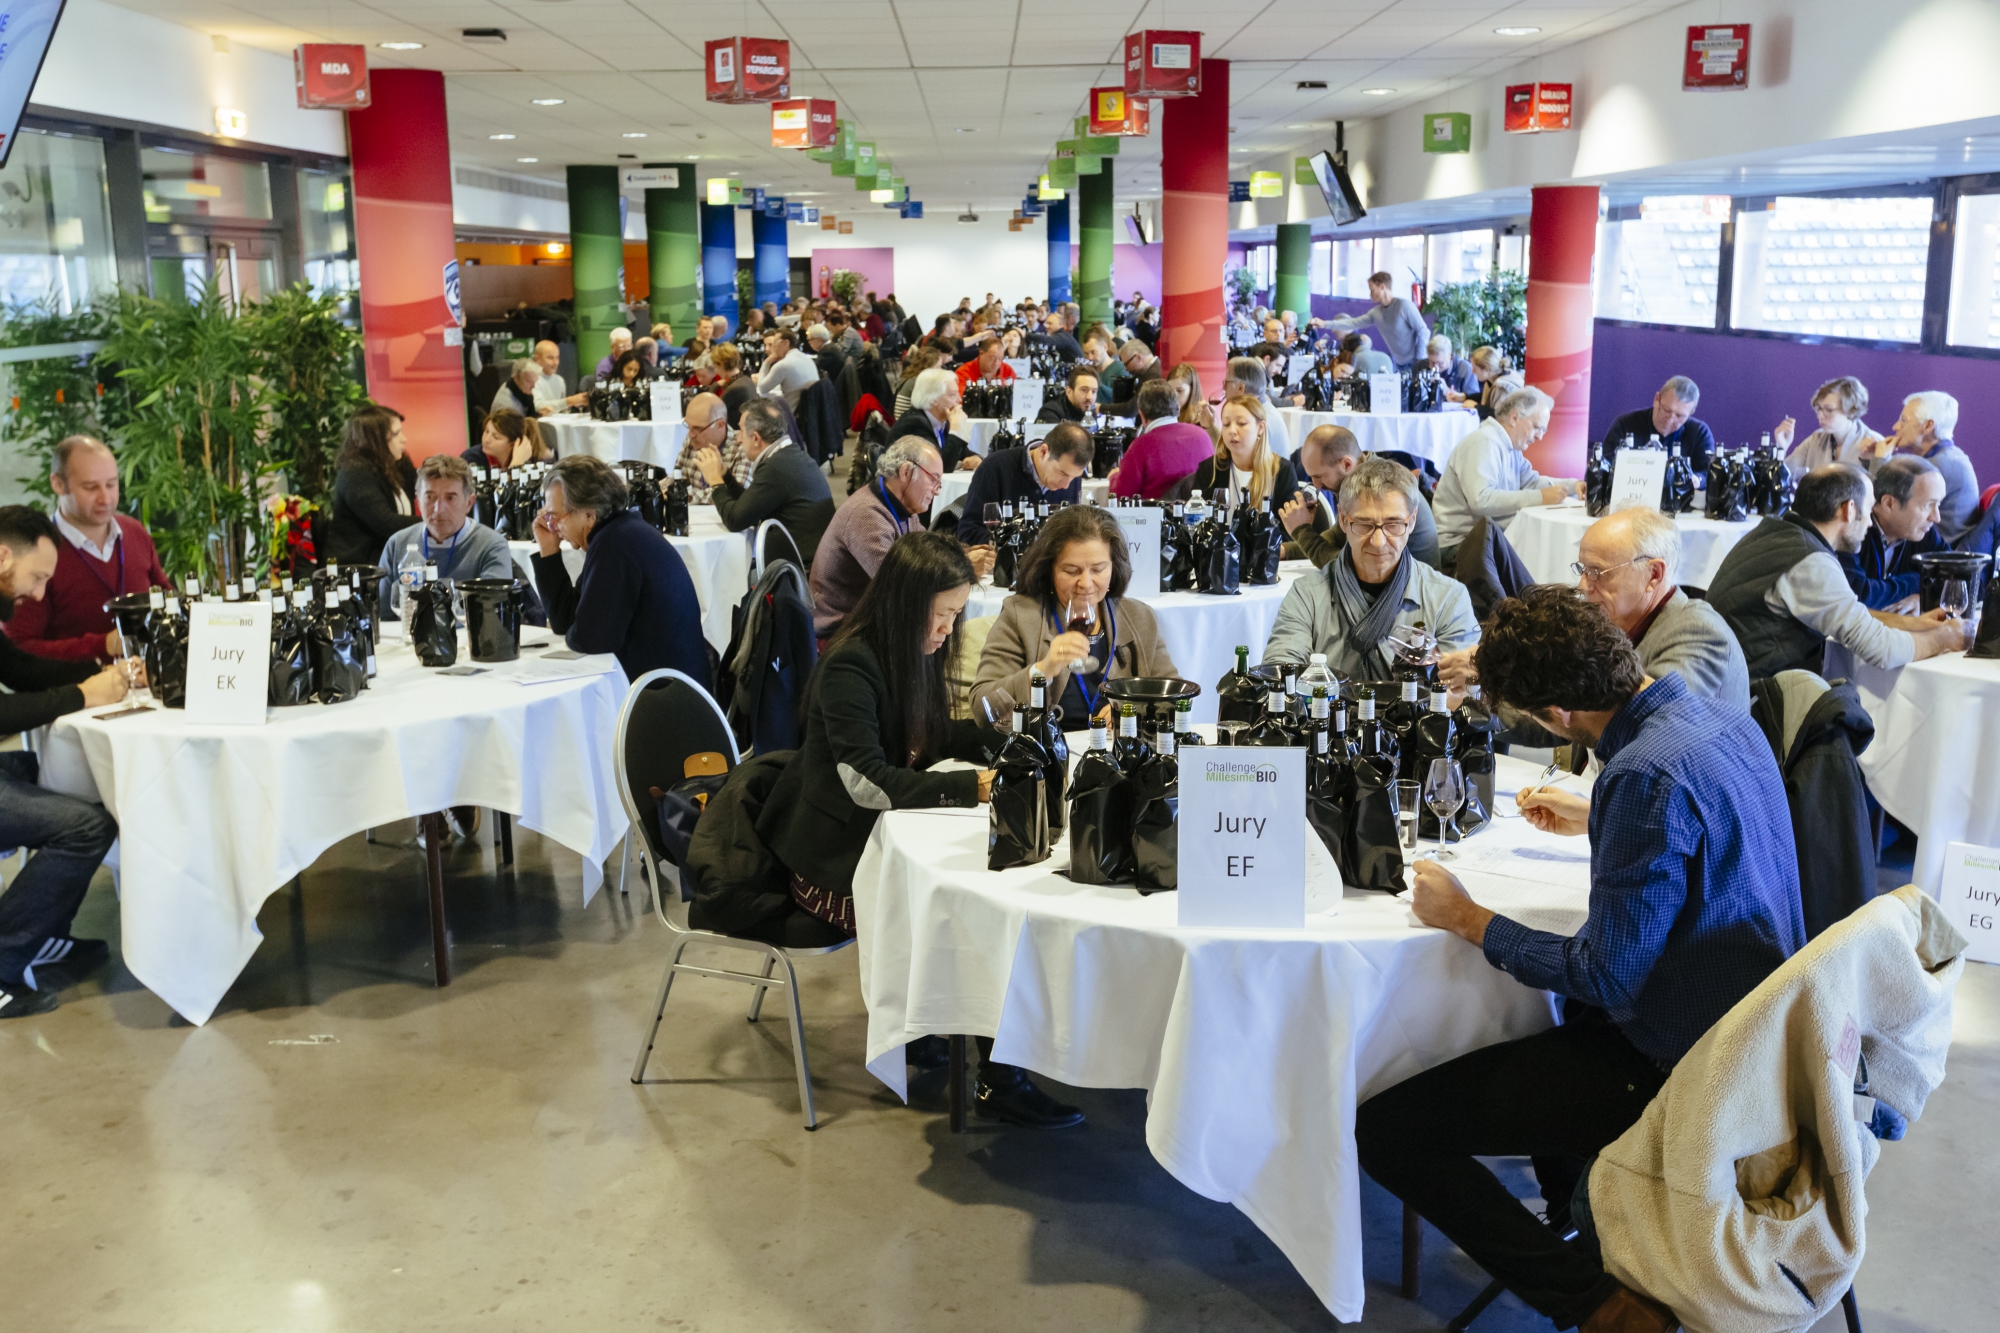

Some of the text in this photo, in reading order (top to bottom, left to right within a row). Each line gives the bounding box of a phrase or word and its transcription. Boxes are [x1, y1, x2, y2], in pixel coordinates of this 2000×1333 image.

[751, 55, 777, 65] CAISSE
[321, 63, 350, 75] MDA
[812, 113, 832, 123] COLAS
[1627, 476, 1648, 488] Jury
[1135, 518, 1147, 526] BIO
[1128, 541, 1141, 554] ry
[239, 618, 253, 627] BIO
[211, 645, 245, 664] Jury
[217, 674, 236, 690] EK
[1206, 761, 1256, 774] Challenge
[1256, 770, 1277, 783] BIO
[1214, 811, 1267, 839] Jury
[1227, 855, 1255, 877] EF
[1966, 885, 2000, 907] Jury
[1969, 913, 1993, 930] EG
